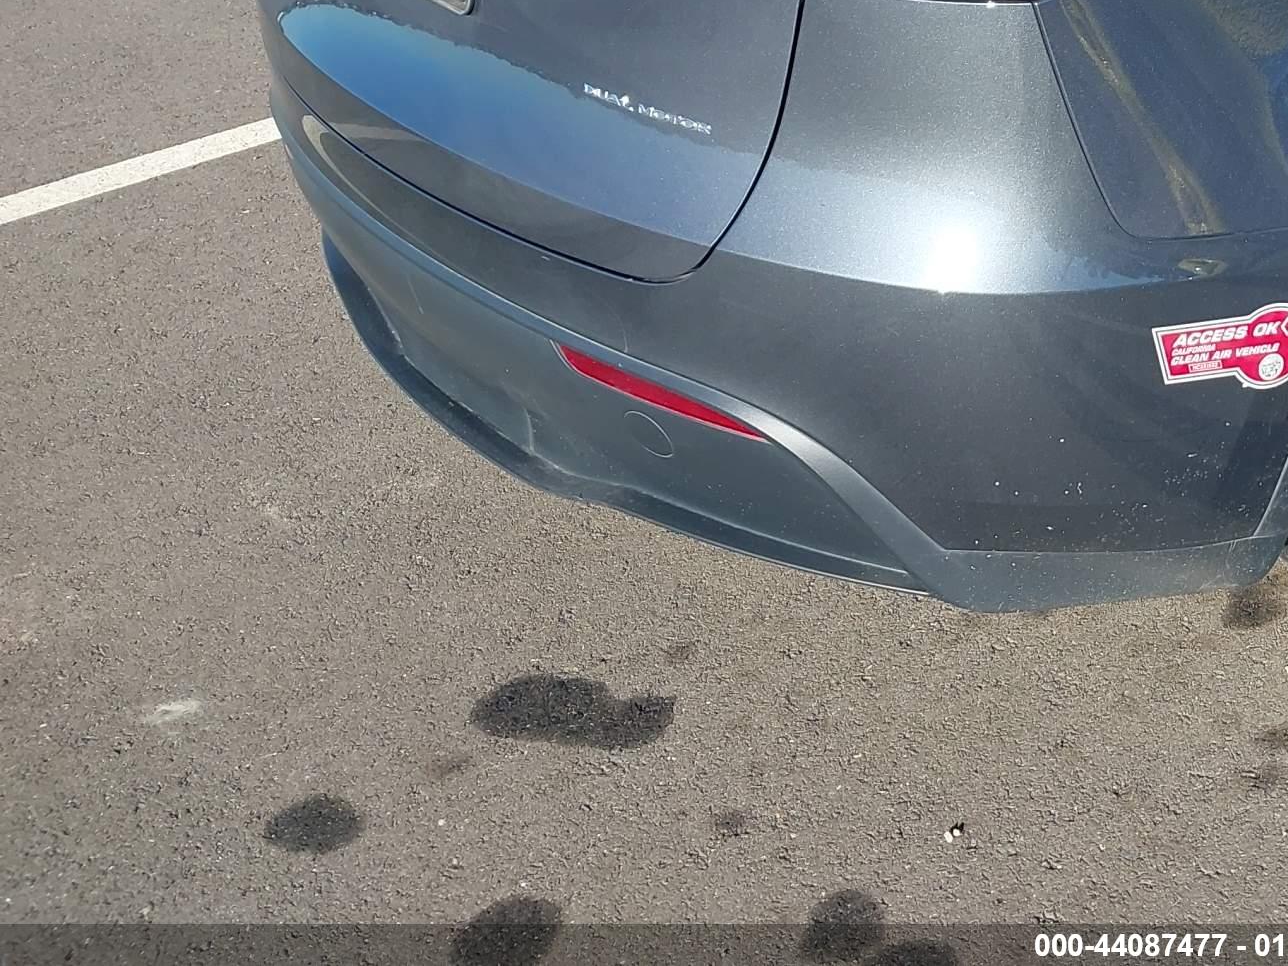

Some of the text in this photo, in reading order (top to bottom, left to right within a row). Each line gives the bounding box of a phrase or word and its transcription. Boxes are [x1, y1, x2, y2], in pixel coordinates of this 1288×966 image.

[1173, 321, 1280, 347] ACCESS OK
[1170, 353, 1209, 367] CLEAN
[1211, 349, 1232, 361] AIR
[1235, 343, 1280, 357] VEHICLE
[1171, 343, 1216, 356] CALIFORNIA
